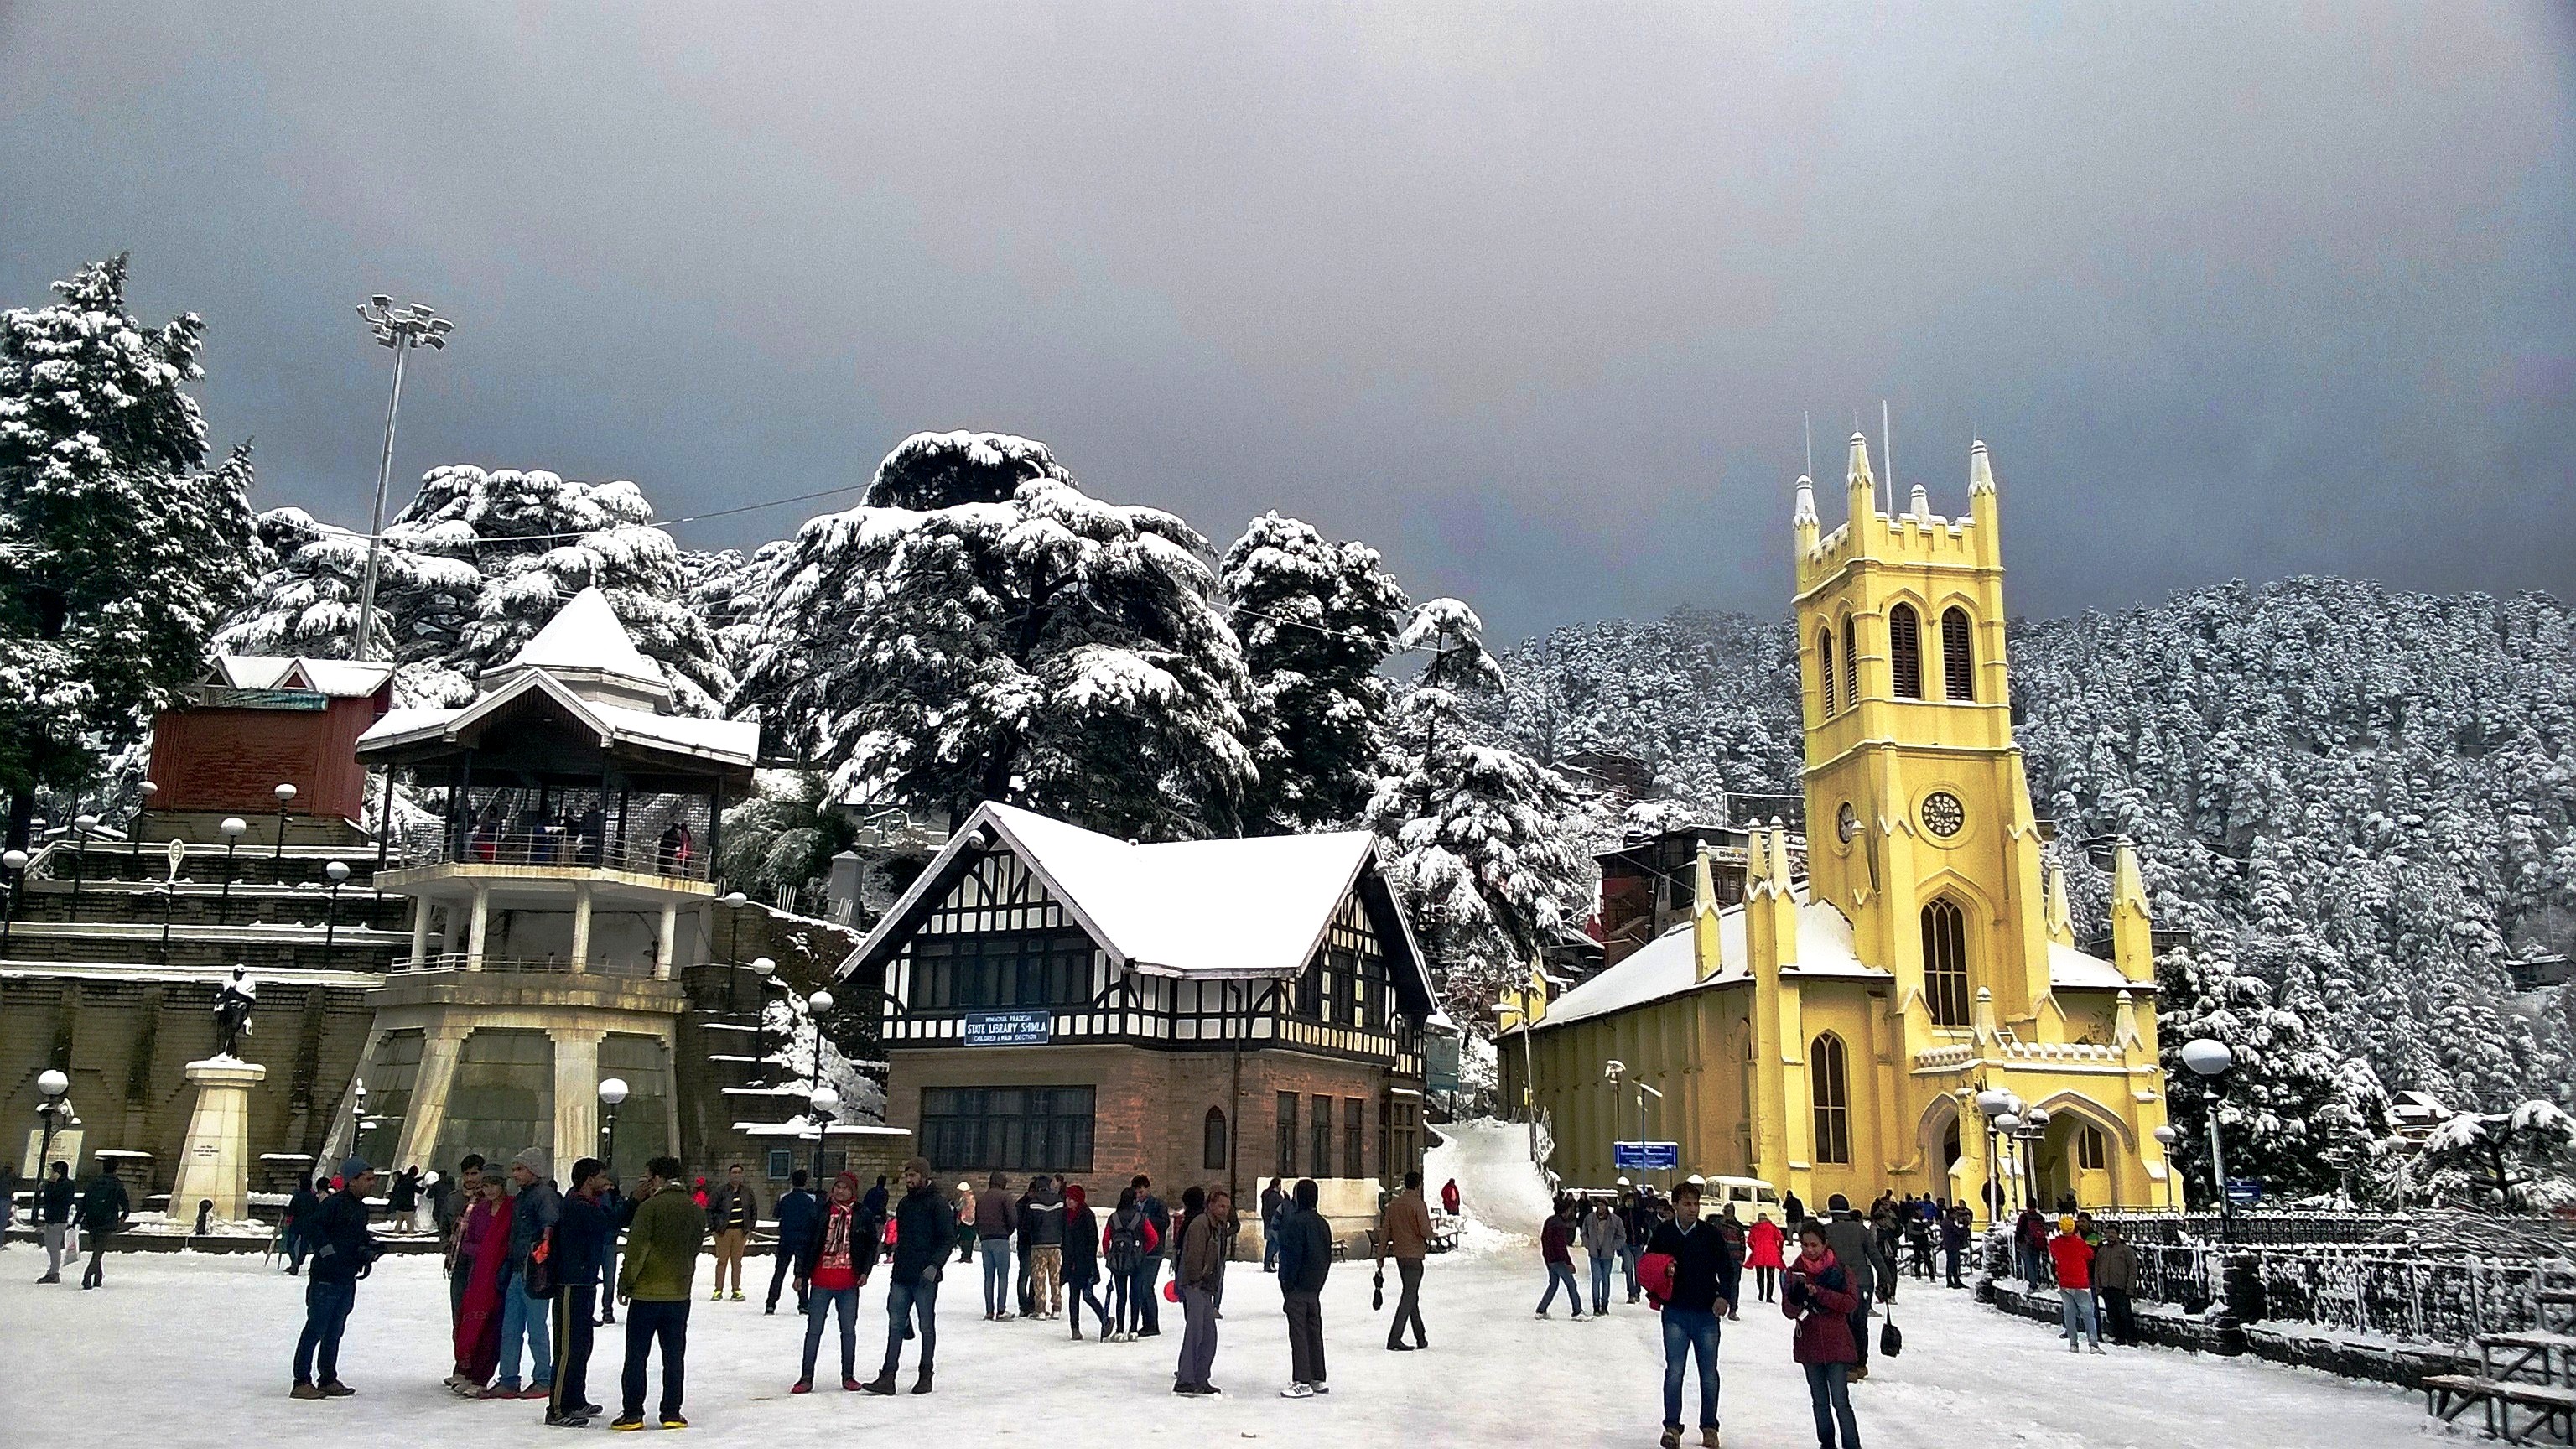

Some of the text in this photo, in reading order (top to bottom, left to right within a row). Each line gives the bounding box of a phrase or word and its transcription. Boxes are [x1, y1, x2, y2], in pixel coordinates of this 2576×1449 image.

[967, 1021, 1046, 1035] STATE LIBRARY SHIMLA
